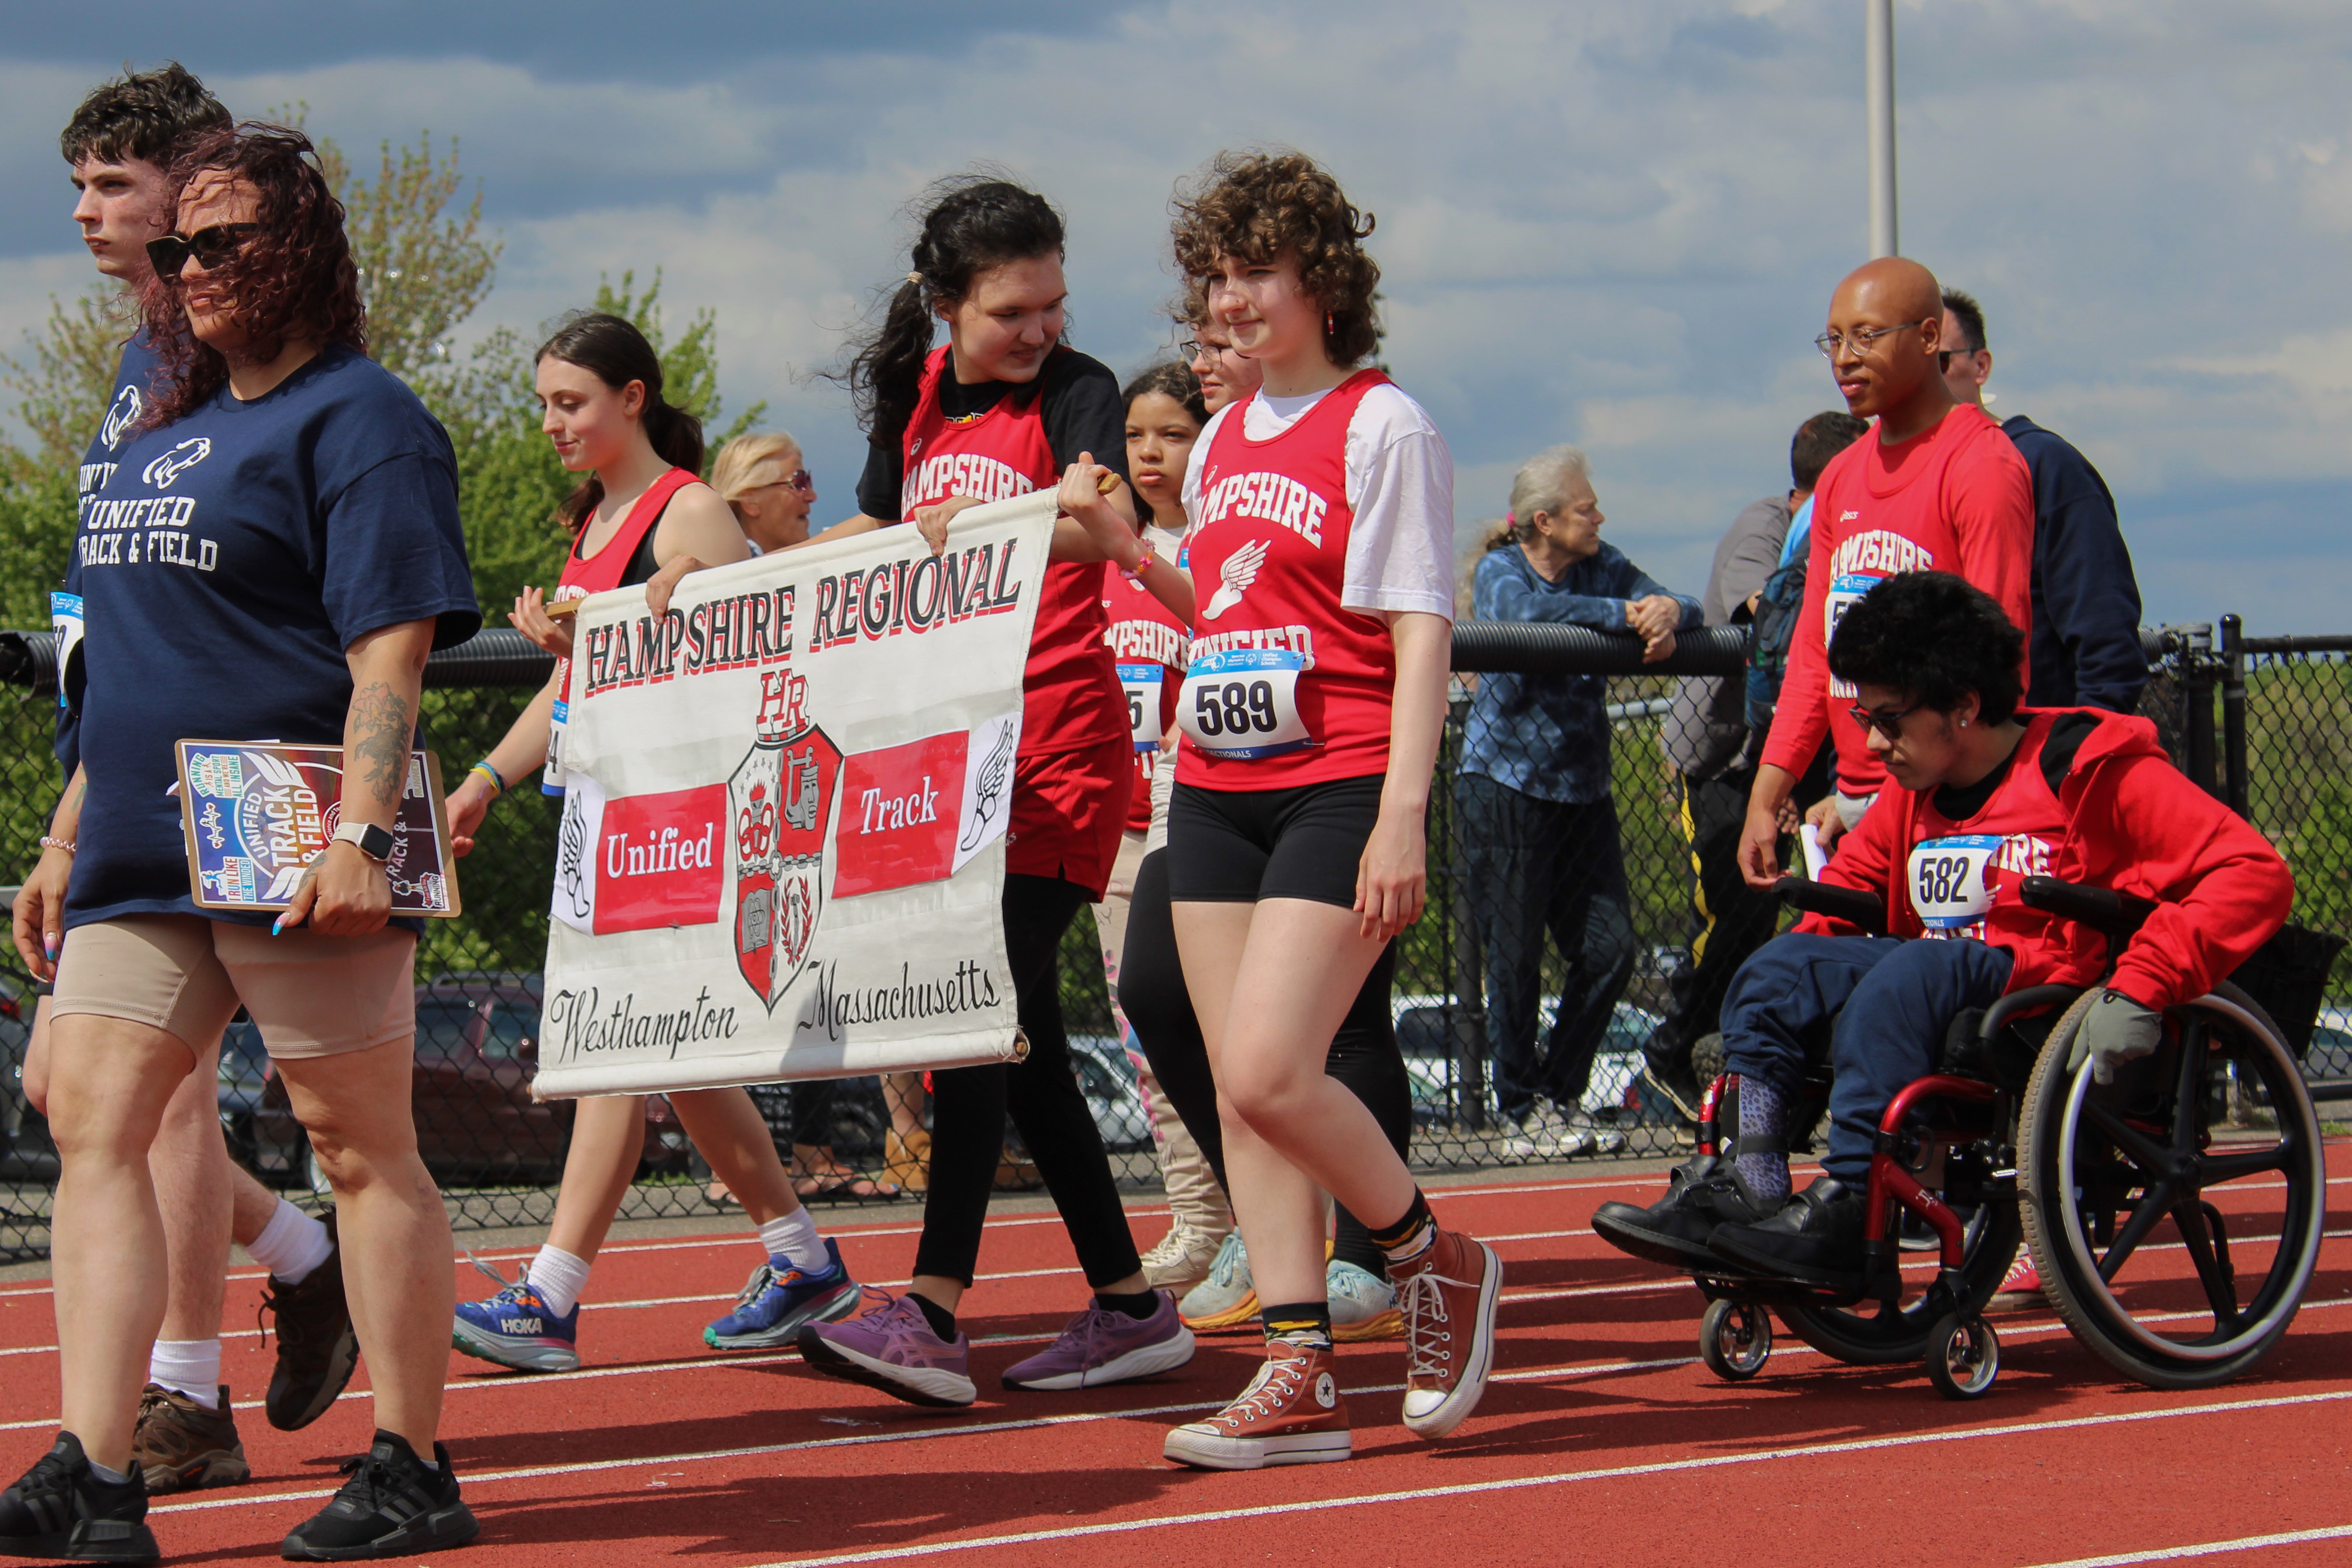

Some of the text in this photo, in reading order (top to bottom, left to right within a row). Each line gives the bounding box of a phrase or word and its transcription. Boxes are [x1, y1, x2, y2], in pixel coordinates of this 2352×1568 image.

[87, 496, 196, 529] UNIFIED
[1189, 471, 1327, 550] AMPSHIRE
[128, 532, 140, 564] &
[147, 530, 218, 571] FIELD
[585, 538, 1022, 699] HAMPSHIRE REGIONAL
[1196, 680, 1278, 736] 589
[191, 754, 210, 796] RUNNING
[212, 756, 224, 797] MENTAL SPORT
[228, 756, 243, 797] ALL INSANE
[242, 792, 270, 859] UNIFIED
[262, 787, 300, 867] TRACK
[293, 789, 324, 863] & FIELD
[859, 776, 939, 835] Track
[225, 858, 239, 876] LIKE
[385, 821, 408, 882] RACK &
[607, 822, 712, 878] Unified
[227, 879, 241, 896] RUN
[240, 860, 253, 900] THE WINDED
[432, 875, 442, 906] RUNNING
[1919, 856, 1969, 904] 582
[549, 959, 1001, 1064] Westhampton Massachusetts
[500, 1317, 543, 1334] HOKA
